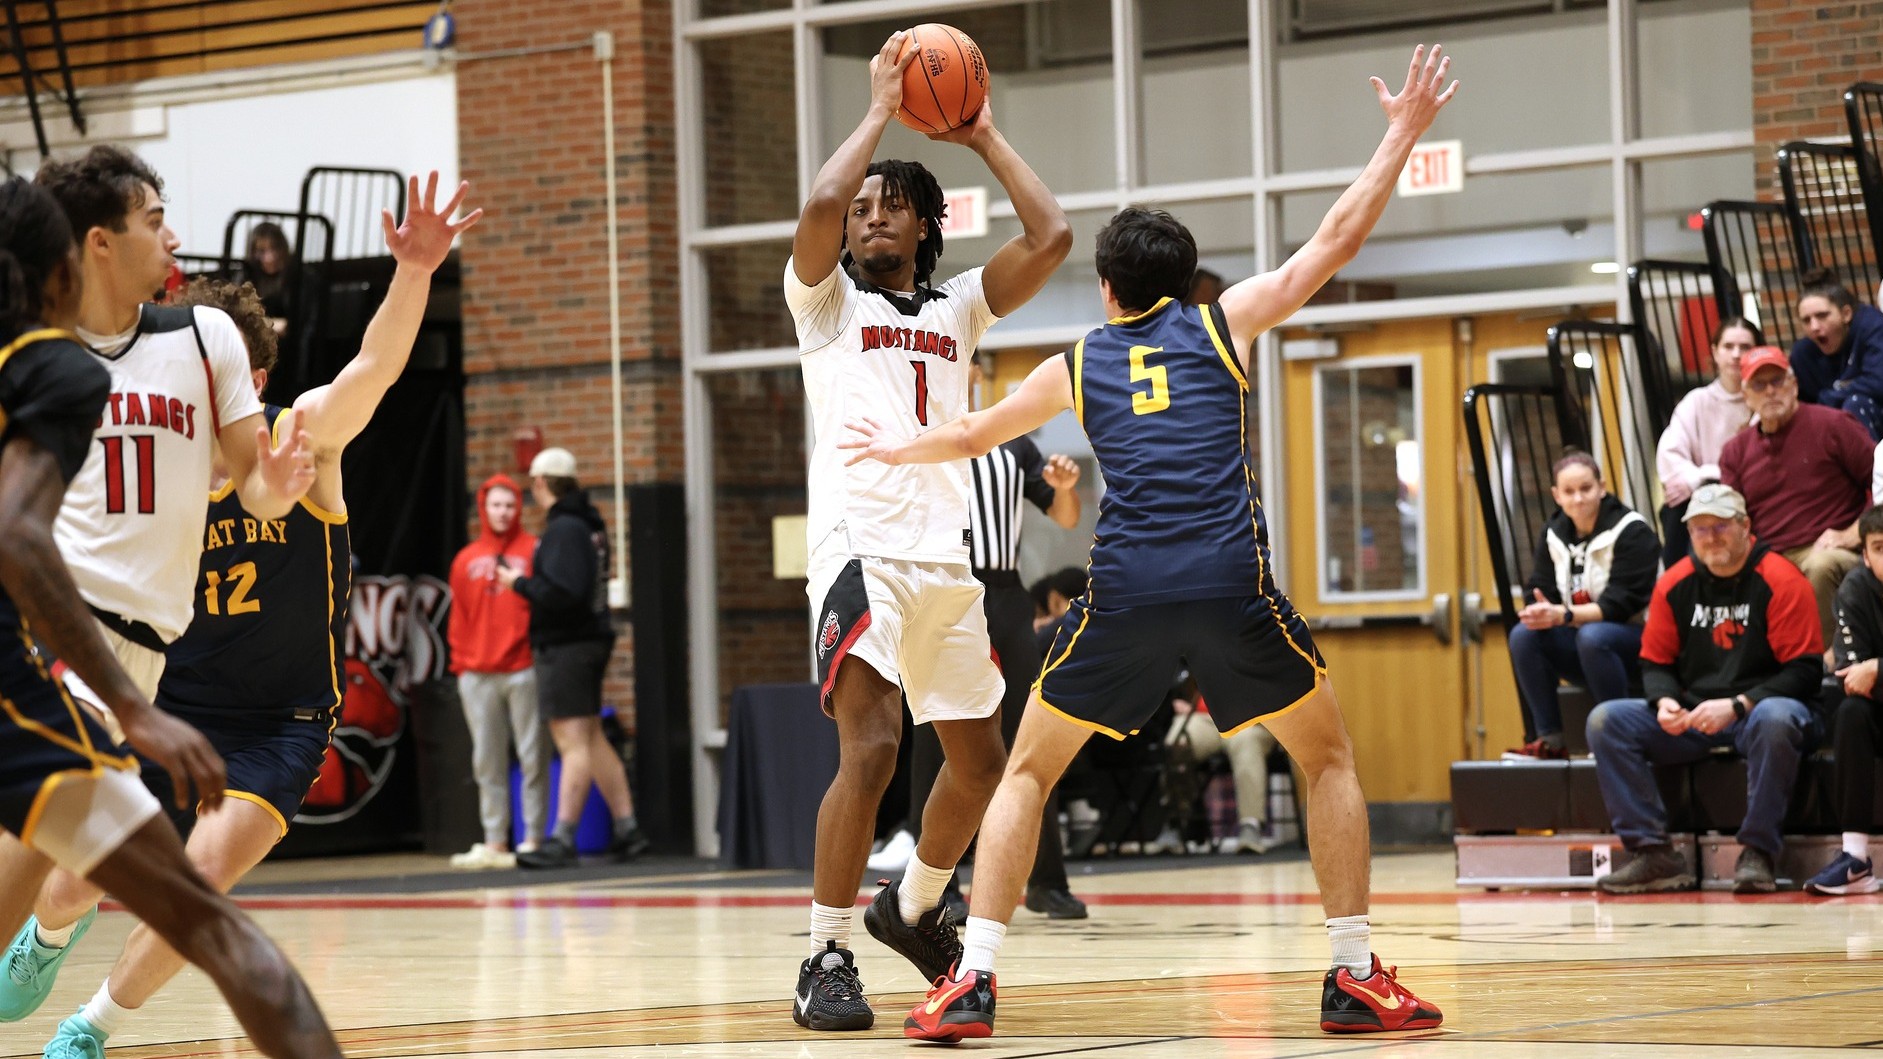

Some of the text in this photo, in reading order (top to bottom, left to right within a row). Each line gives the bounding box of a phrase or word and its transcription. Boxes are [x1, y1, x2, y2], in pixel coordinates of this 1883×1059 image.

[927, 54, 940, 77] NFHS
[1410, 148, 1450, 188] EXIT
[861, 325, 957, 362] MUSTANGS
[909, 360, 928, 426] 1
[1129, 345, 1171, 416] 5
[97, 392, 196, 440] TANGS
[97, 435, 155, 514] 11
[242, 518, 287, 543] BAY
[205, 561, 261, 616] 12
